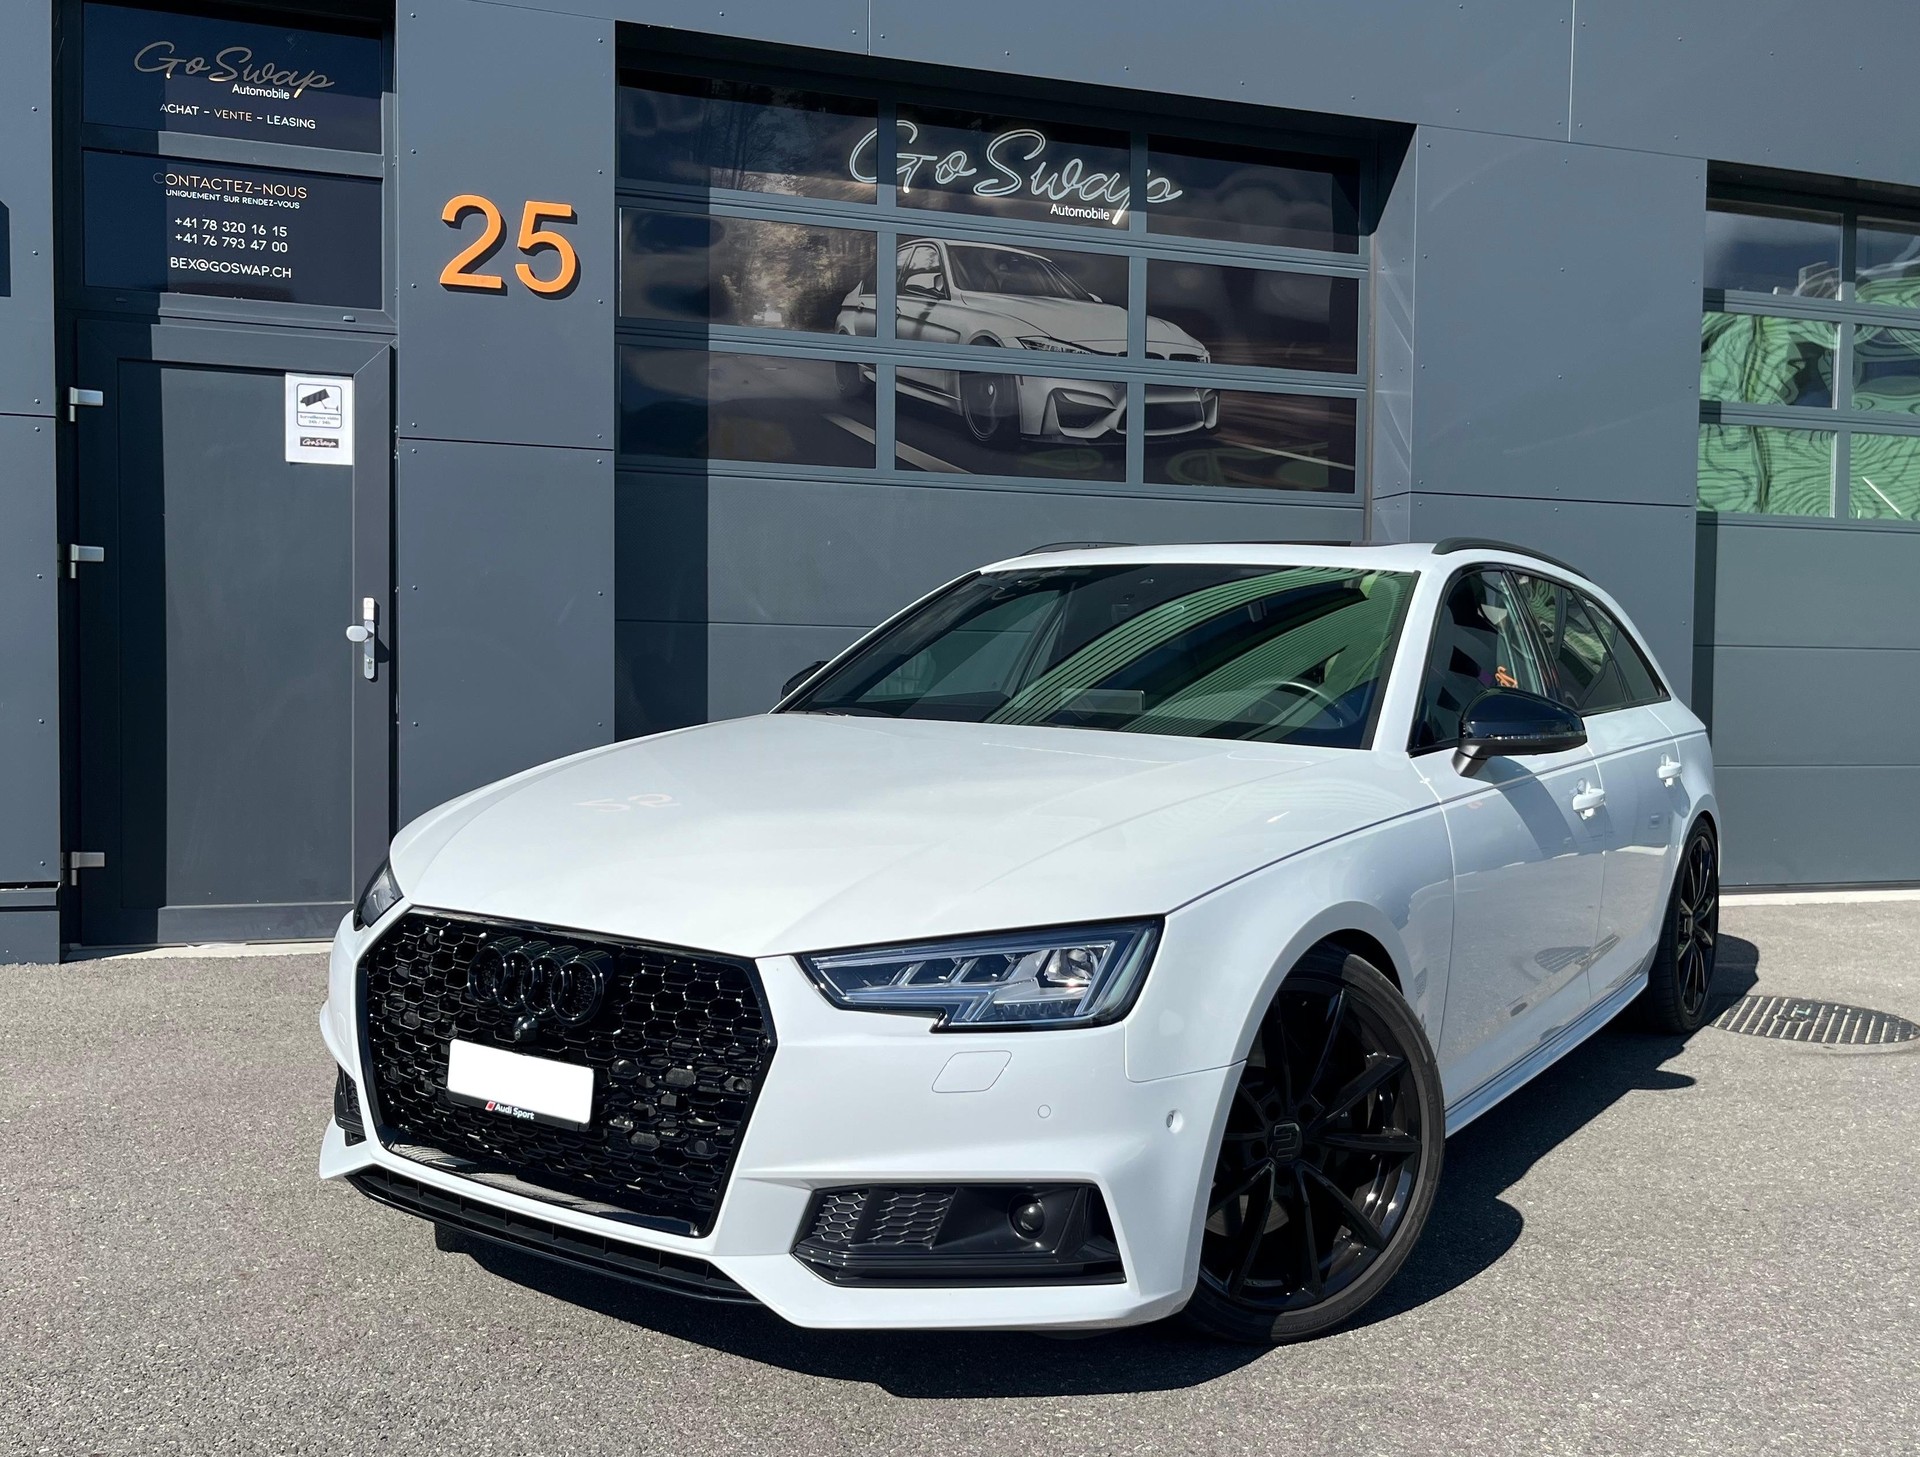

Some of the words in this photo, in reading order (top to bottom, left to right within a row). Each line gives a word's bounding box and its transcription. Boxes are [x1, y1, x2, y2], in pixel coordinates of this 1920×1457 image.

[134, 41, 335, 98] GoSwap
[232, 83, 290, 100] Automobile
[159, 103, 199, 116] ACHAT
[214, 108, 252, 122] VENTE
[266, 114, 316, 129] LEASING
[152, 172, 308, 199] CONTACTEZ-NOUS
[165, 189, 221, 201] UNIQUEMENT
[223, 195, 240, 203] SUR
[242, 197, 300, 209] RENDEZ-VOUS
[1050, 203, 1110, 221] Automobile
[174, 217, 198, 229] +41
[202, 219, 218, 231] 78
[222, 221, 246, 233] 320
[251, 224, 267, 236] 16
[272, 226, 288, 237] 15
[175, 233, 198, 245] +41
[202, 235, 218, 247] 76
[221, 236, 246, 250] 793
[250, 240, 267, 251] 47
[271, 241, 288, 253] 00
[439, 194, 577, 293] 25
[170, 256, 292, 279] BEX@GOSWAP.CH
[494, 1104, 513, 1114] Audi
[513, 1107, 535, 1120] Sport
